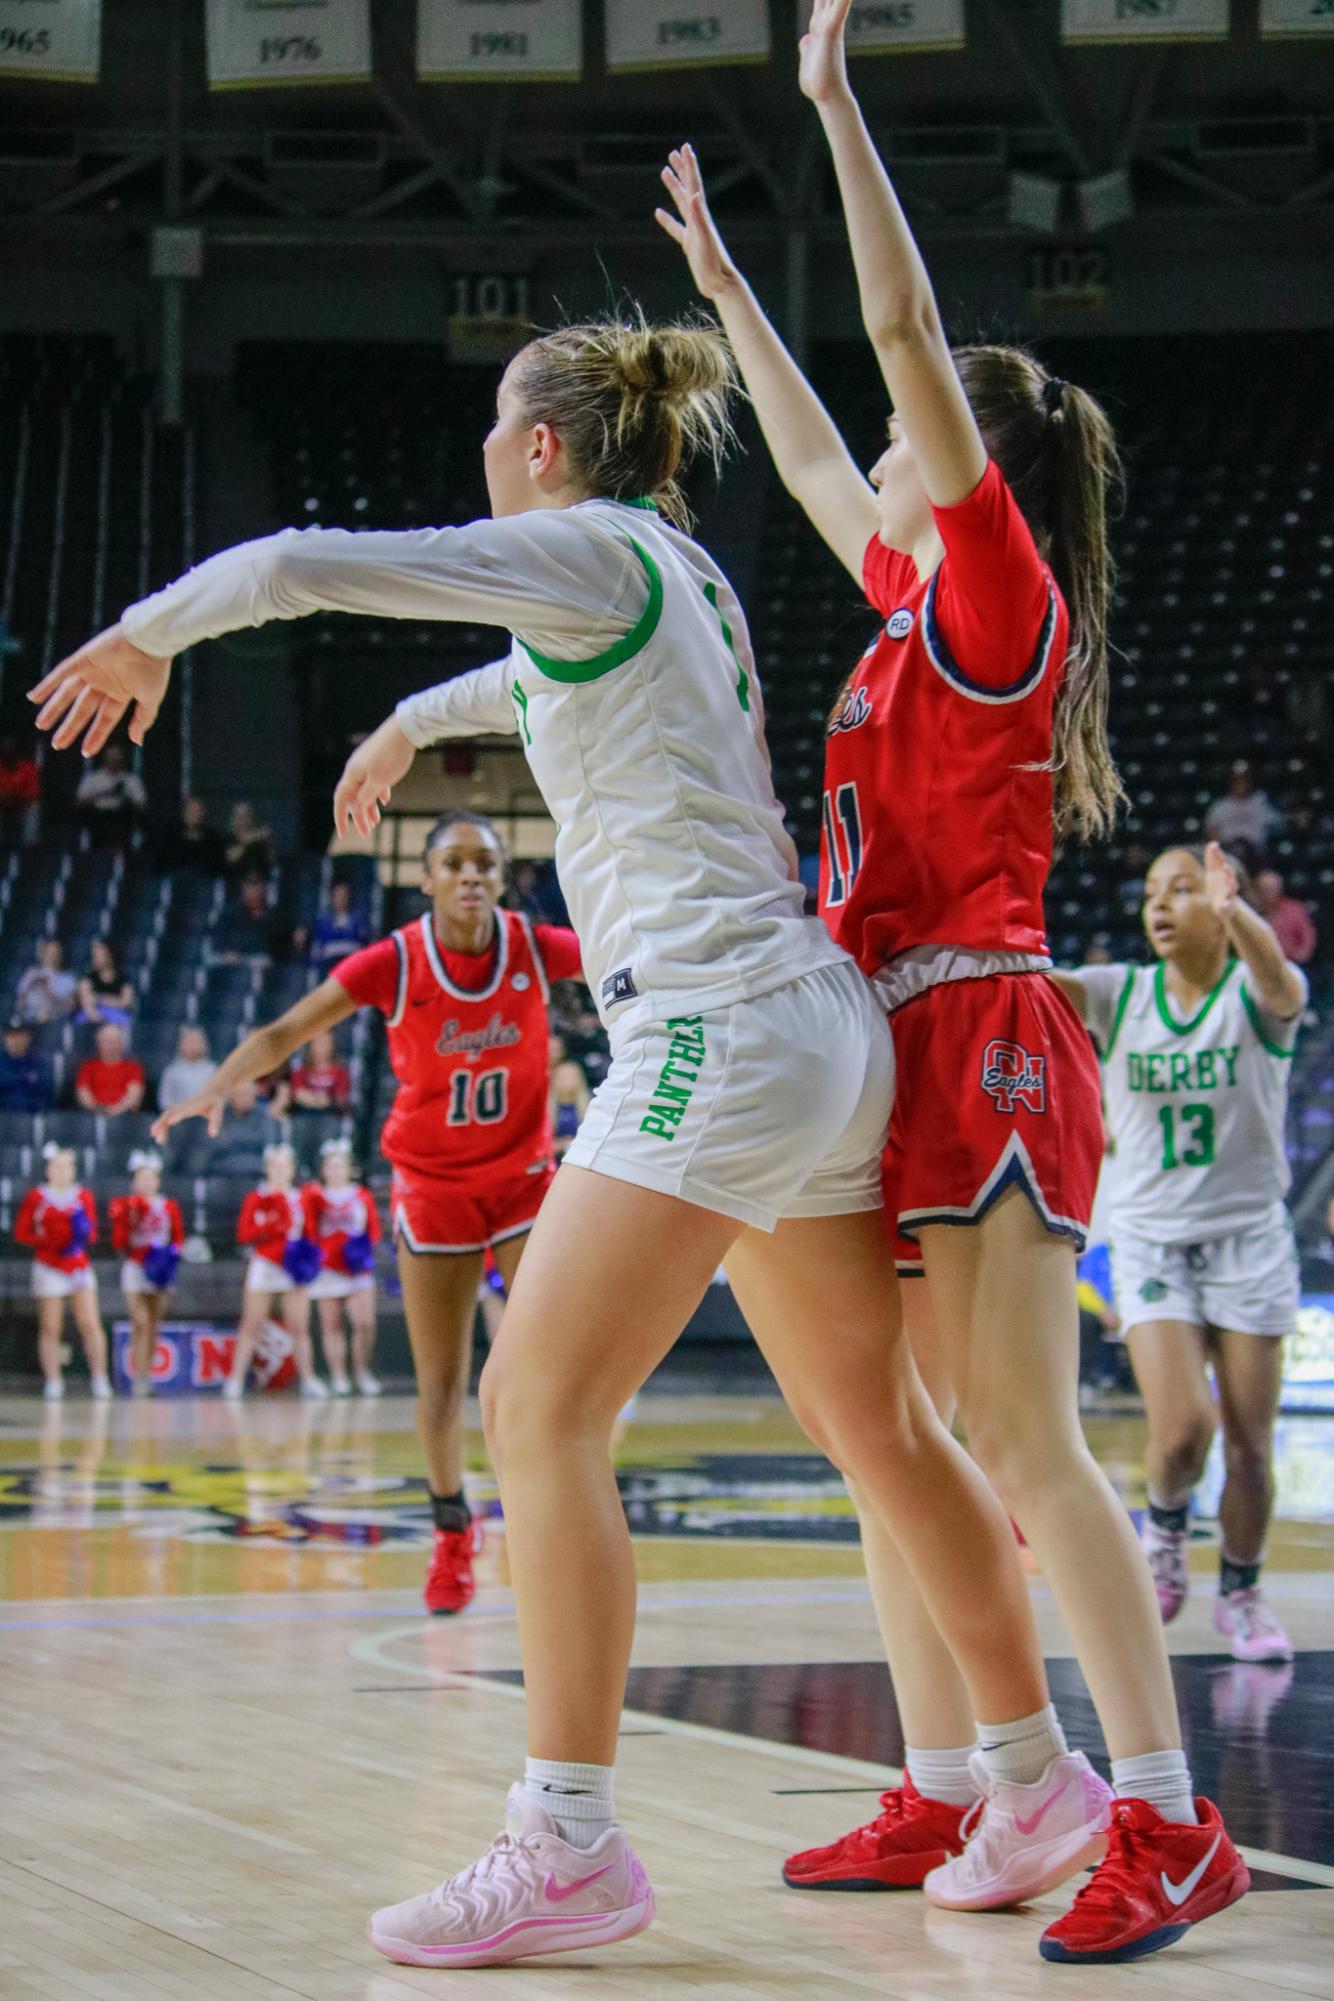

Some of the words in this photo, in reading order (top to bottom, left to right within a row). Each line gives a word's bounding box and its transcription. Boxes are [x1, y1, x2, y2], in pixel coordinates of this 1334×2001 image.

[260, 37, 322, 64] 1976
[1031, 251, 1105, 297] 102
[453, 277, 529, 320] 101
[823, 781, 863, 908] 11
[433, 1013, 523, 1064] Eagles
[983, 1067, 1042, 1096] Eagles
[1127, 1045, 1240, 1092] DERBY
[446, 1066, 509, 1127] 10
[1158, 1103, 1215, 1170] 13
